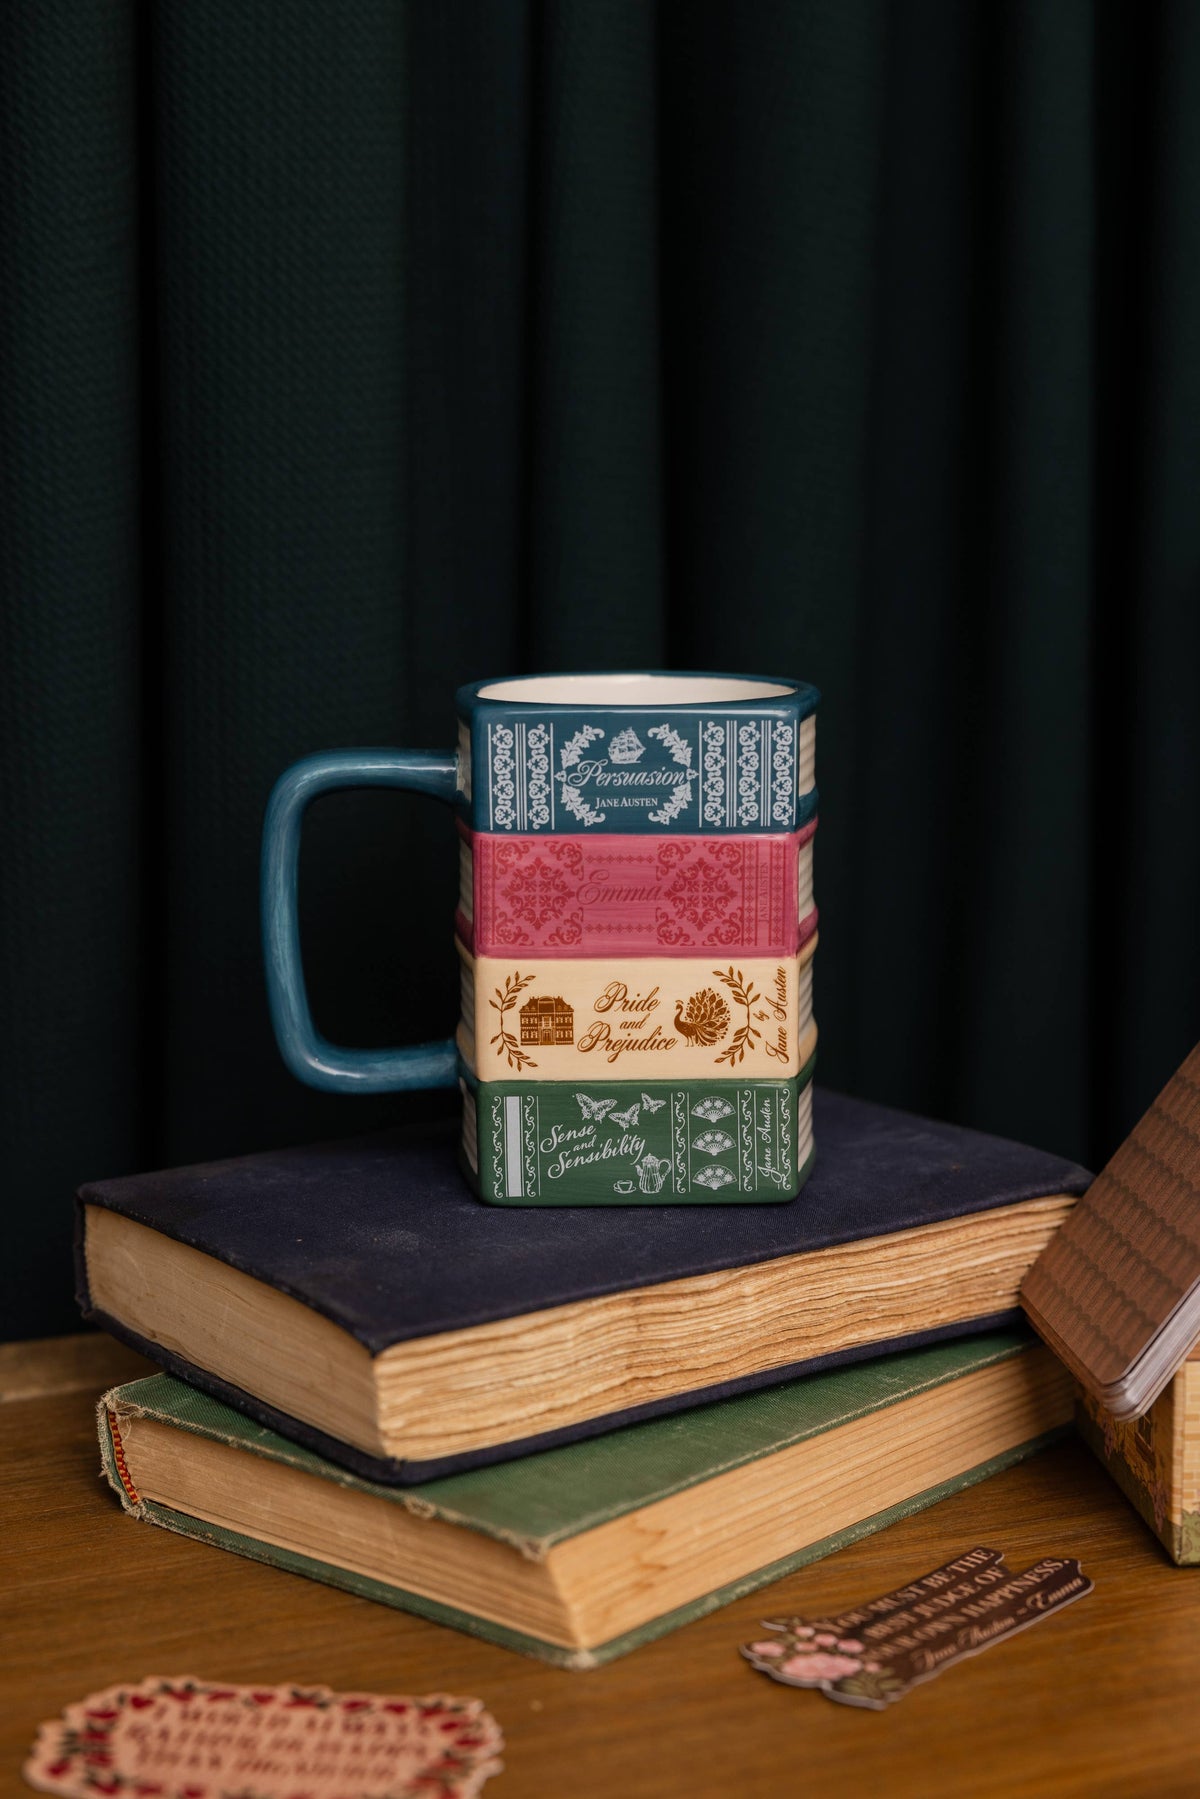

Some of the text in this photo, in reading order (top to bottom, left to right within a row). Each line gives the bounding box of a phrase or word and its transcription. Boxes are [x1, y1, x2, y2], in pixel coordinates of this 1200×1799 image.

[567, 759, 688, 788] Persuasion
[595, 797, 659, 809] JANE AUSTEN
[576, 869, 666, 906] Emma
[593, 981, 661, 1013] Pride
[765, 965, 790, 1064] Jane Austen
[620, 1016, 647, 1031] and
[753, 1010, 770, 1022] by
[577, 1021, 679, 1064] Prejudice
[540, 1123, 597, 1153] Sense
[572, 1139, 596, 1152] and
[757, 1097, 783, 1183] Jane Austen
[547, 1134, 646, 1179] Sensibility
[921, 1571, 957, 1589] BE
[946, 1549, 995, 1574] THE
[911, 1582, 982, 1619] JUDGE
[974, 1566, 1005, 1586] OF
[960, 1559, 1071, 1618] HAPPINESS.
[1026, 1577, 1083, 1610] Emma
